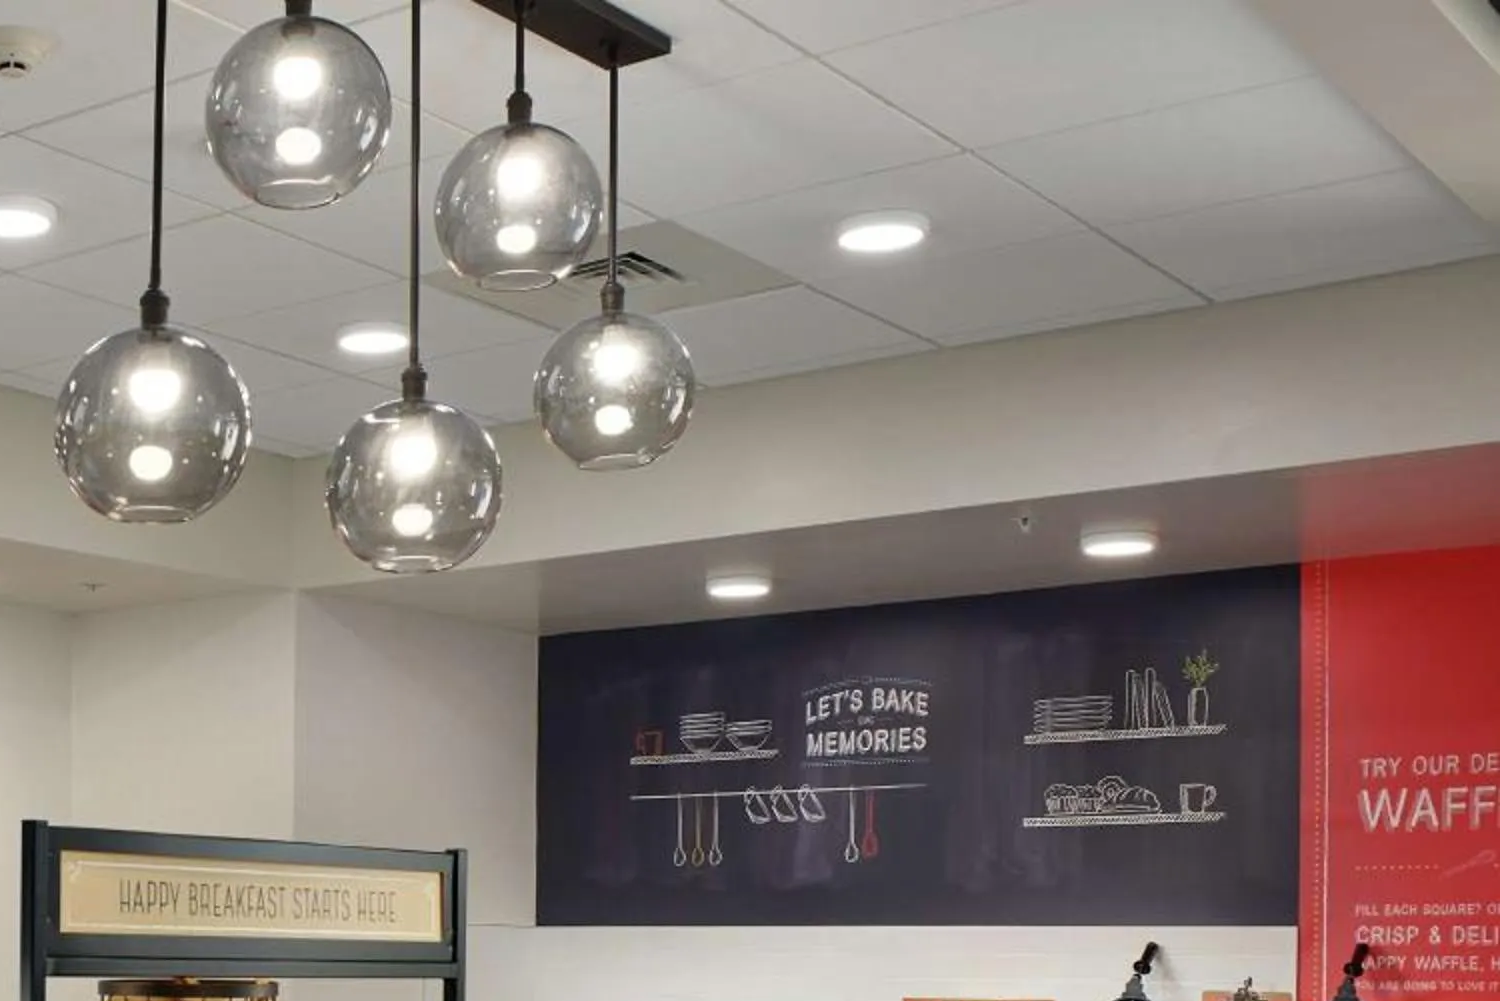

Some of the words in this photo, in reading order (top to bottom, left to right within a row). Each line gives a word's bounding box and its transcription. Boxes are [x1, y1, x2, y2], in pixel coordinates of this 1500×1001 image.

[805, 689, 863, 725] LET'S
[871, 687, 929, 717] BAKE
[806, 726, 927, 757] MEMORIES
[1360, 757, 1401, 778] TRY
[1412, 754, 1460, 776] OUR
[1357, 785, 1500, 834] WAFF
[119, 879, 181, 914] HAPPY
[188, 882, 286, 920] BREAKFAST
[292, 887, 351, 922] STARTS
[356, 888, 397, 923] HERE
[1355, 905, 1379, 917] FILL
[1384, 904, 1418, 916] EACH
[1423, 903, 1481, 916] SQUARE?
[1356, 925, 1419, 946] CRISP
[1429, 925, 1441, 944] &
[1361, 955, 1407, 971] APPY
